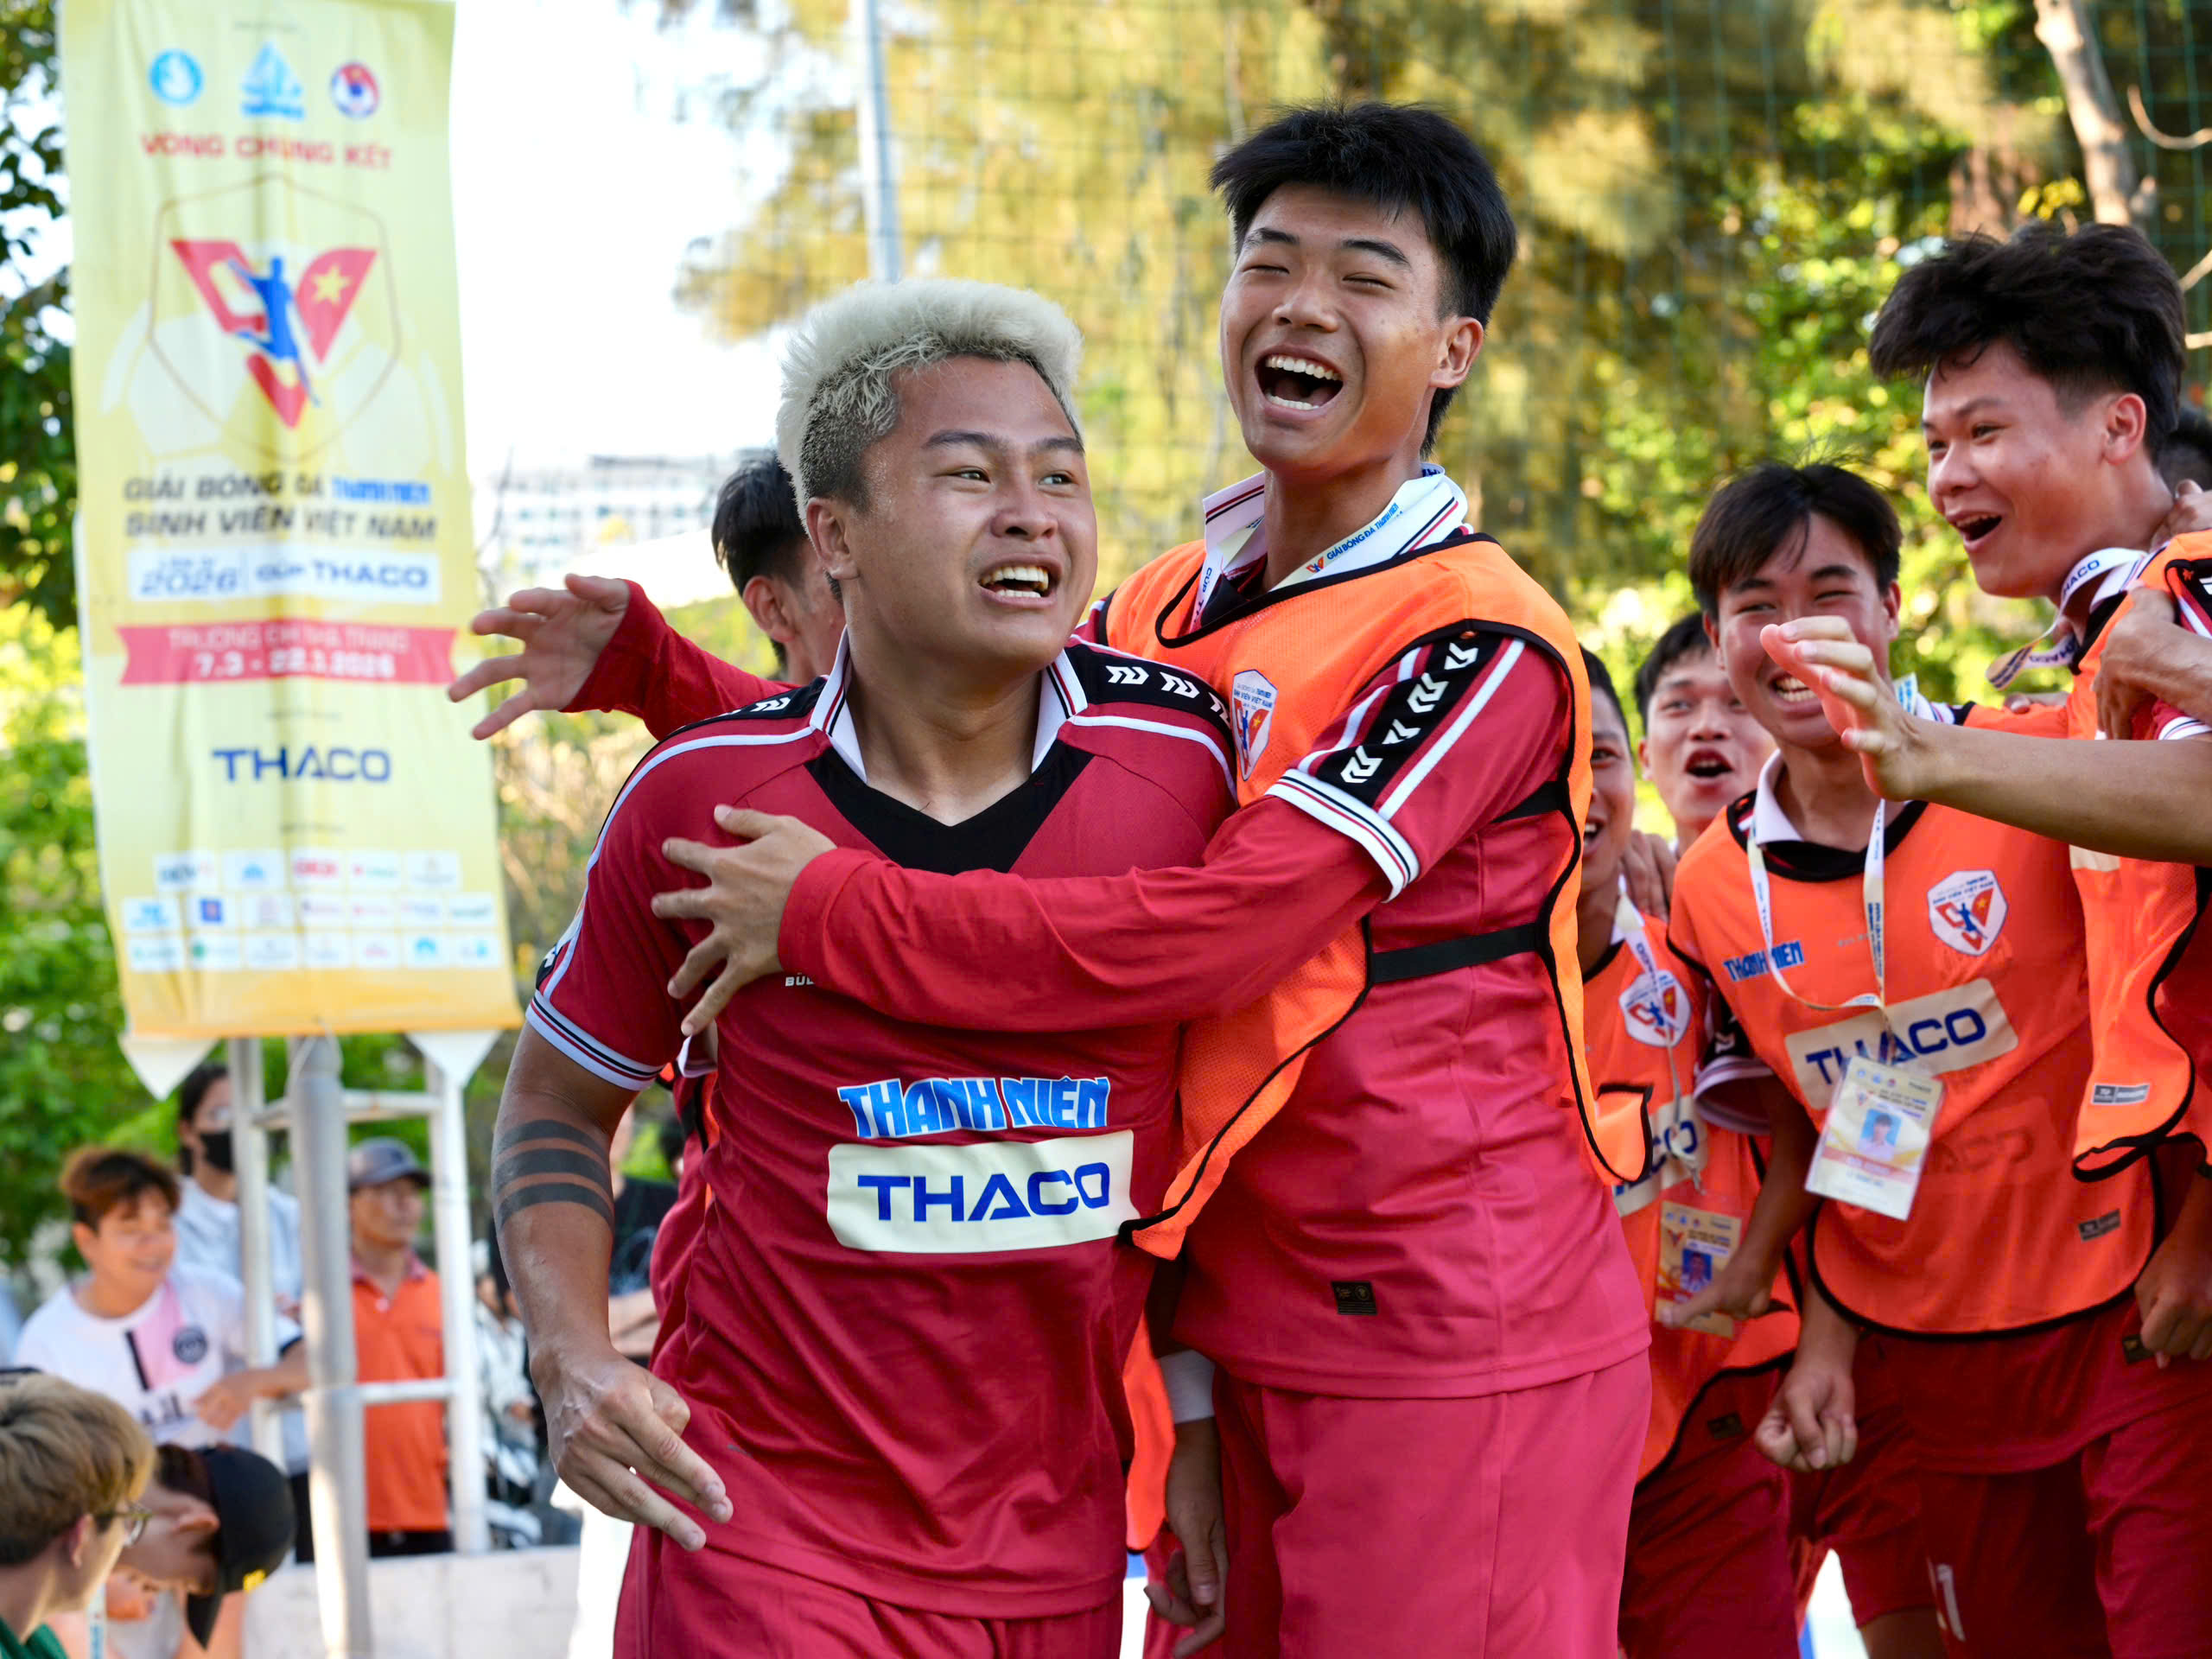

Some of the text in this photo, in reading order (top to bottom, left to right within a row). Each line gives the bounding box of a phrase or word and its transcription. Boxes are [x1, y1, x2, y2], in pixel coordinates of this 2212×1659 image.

[366, 516, 436, 539] NAM
[141, 566, 238, 595] 2026
[312, 560, 429, 588] THACO
[213, 747, 391, 783] THACO
[836, 1075, 1111, 1138] THANH NIÊN
[857, 1161, 1110, 1223] THACO
